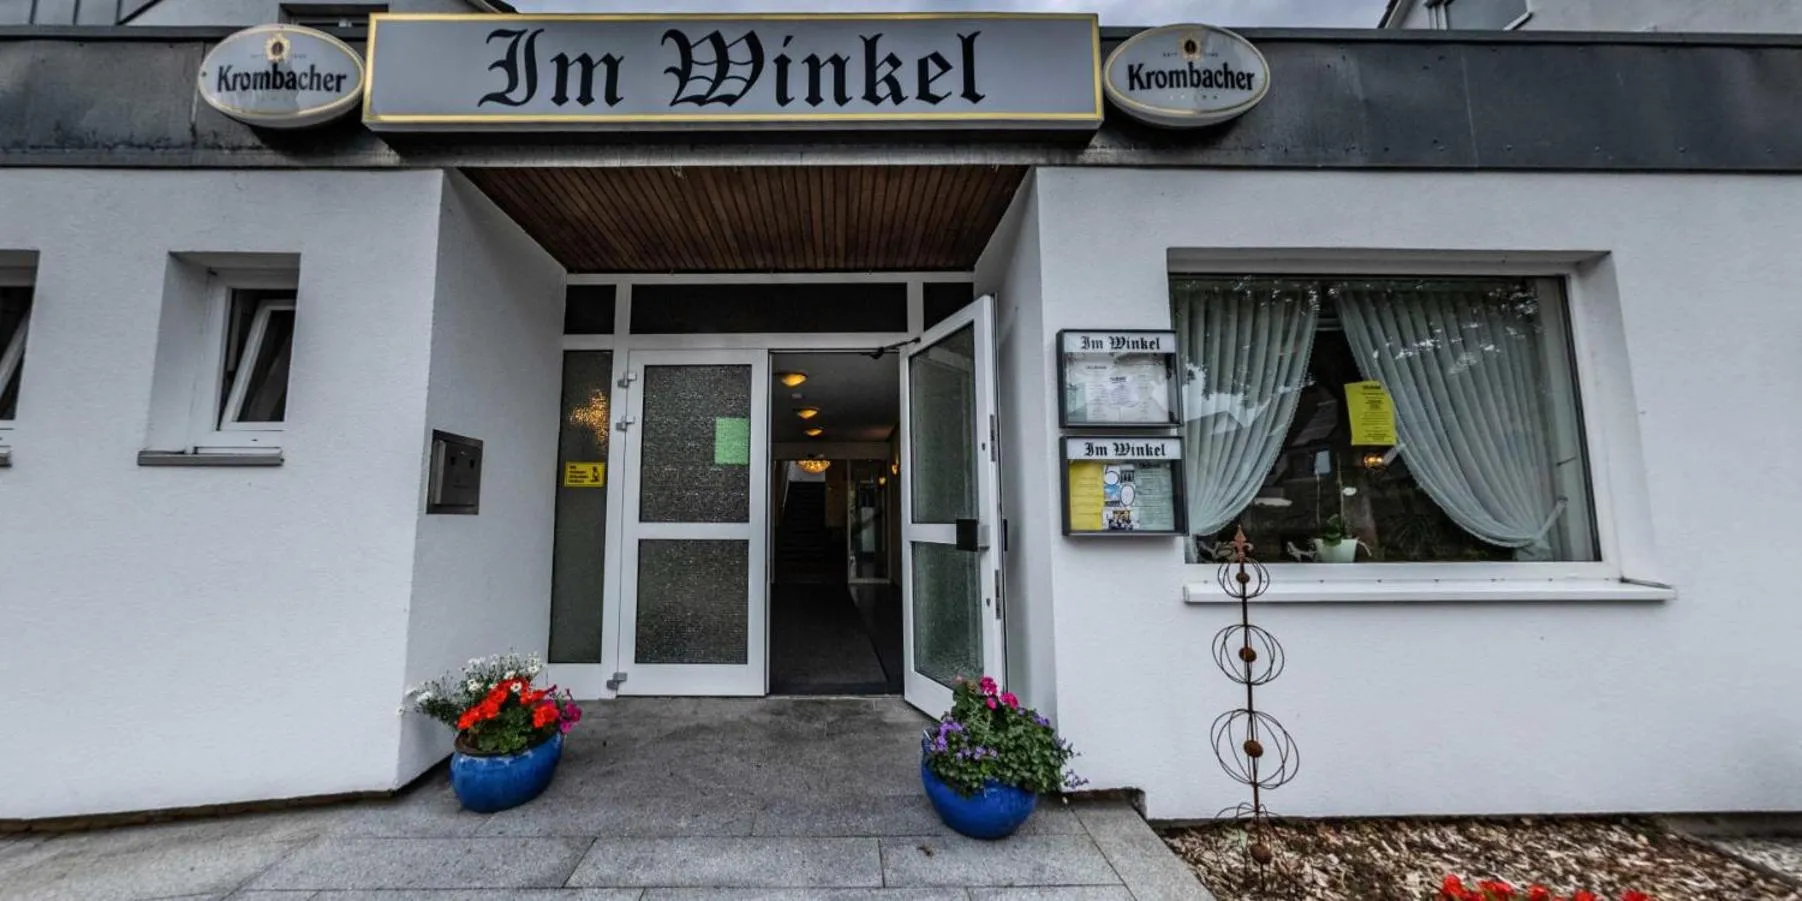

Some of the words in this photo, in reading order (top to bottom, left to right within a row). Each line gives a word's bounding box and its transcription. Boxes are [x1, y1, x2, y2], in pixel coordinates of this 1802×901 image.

[217, 63, 347, 93] Krombacher
[477, 28, 624, 108] Im
[660, 28, 987, 108] Winkel
[1128, 62, 1255, 91] Krombacher
[1080, 335, 1103, 350] Im
[1108, 335, 1161, 350] Winkel
[1084, 441, 1108, 457] Im
[1113, 441, 1166, 457] Winkel
